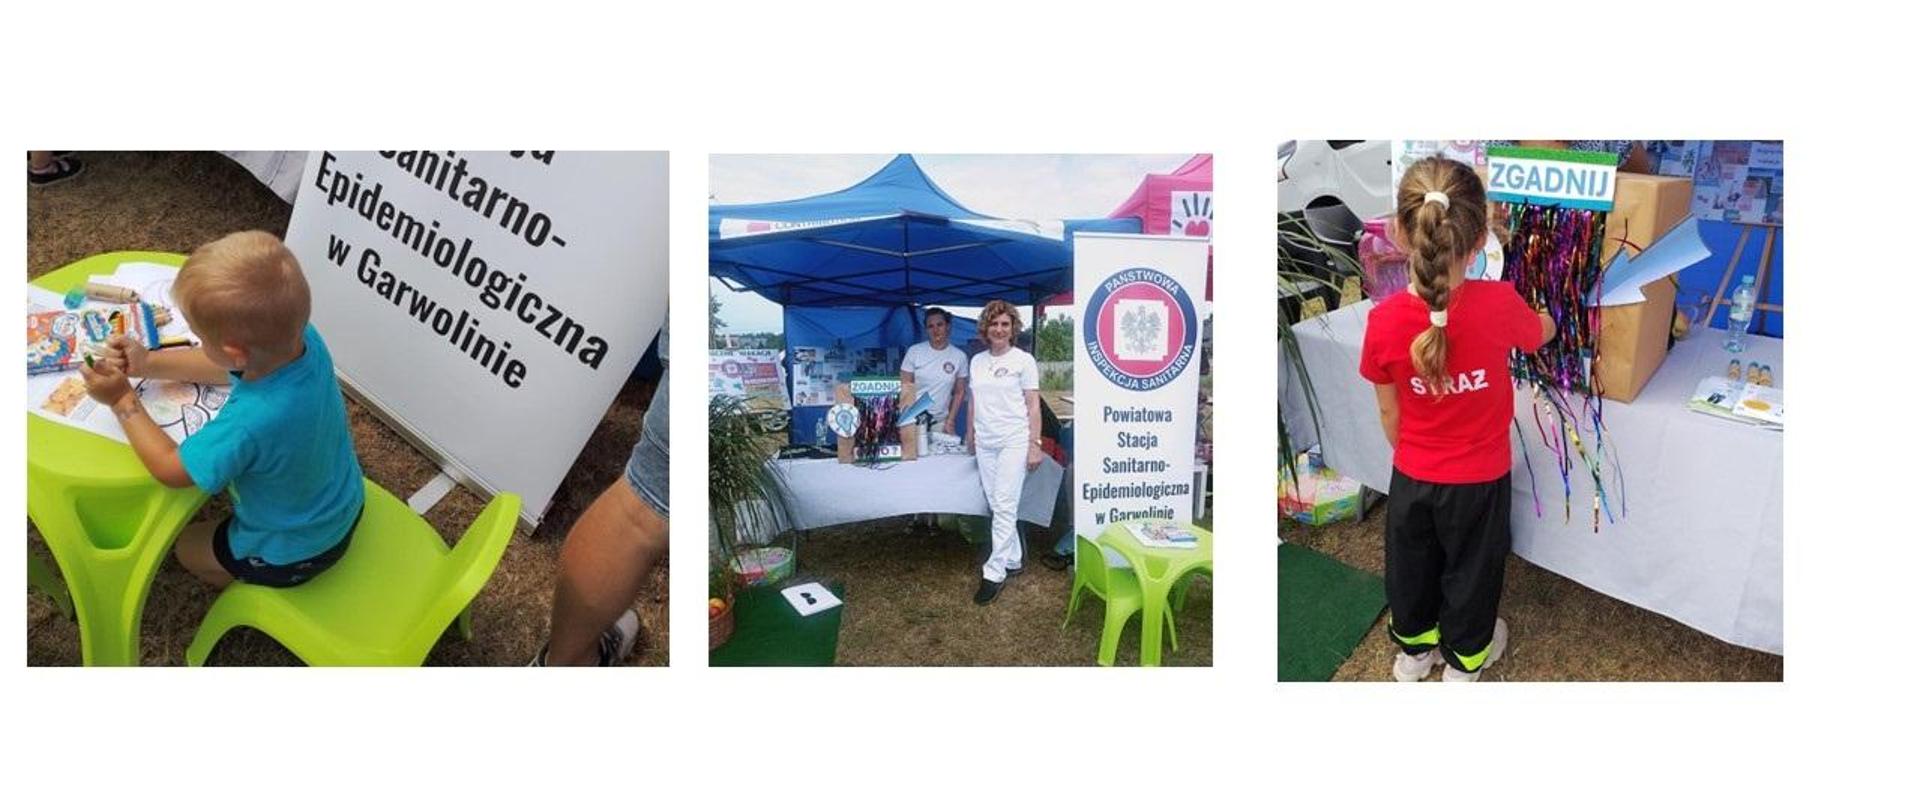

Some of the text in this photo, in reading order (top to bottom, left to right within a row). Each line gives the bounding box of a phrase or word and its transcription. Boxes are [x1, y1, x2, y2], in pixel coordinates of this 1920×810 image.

[1490, 162, 1609, 198] ZGADNIJ
[314, 151, 610, 371] Epidemiologiczna
[327, 234, 528, 389] w Garwolinie
[1087, 341, 1193, 390] INSPEKCJA SANITARNA
[1103, 406, 1173, 423] Powiatowa
[1117, 431, 1158, 450] Stacja
[1102, 457, 1171, 474] Sanitarno-
[1082, 481, 1190, 503] Epidemiologiczna
[1095, 512, 1106, 525] w
